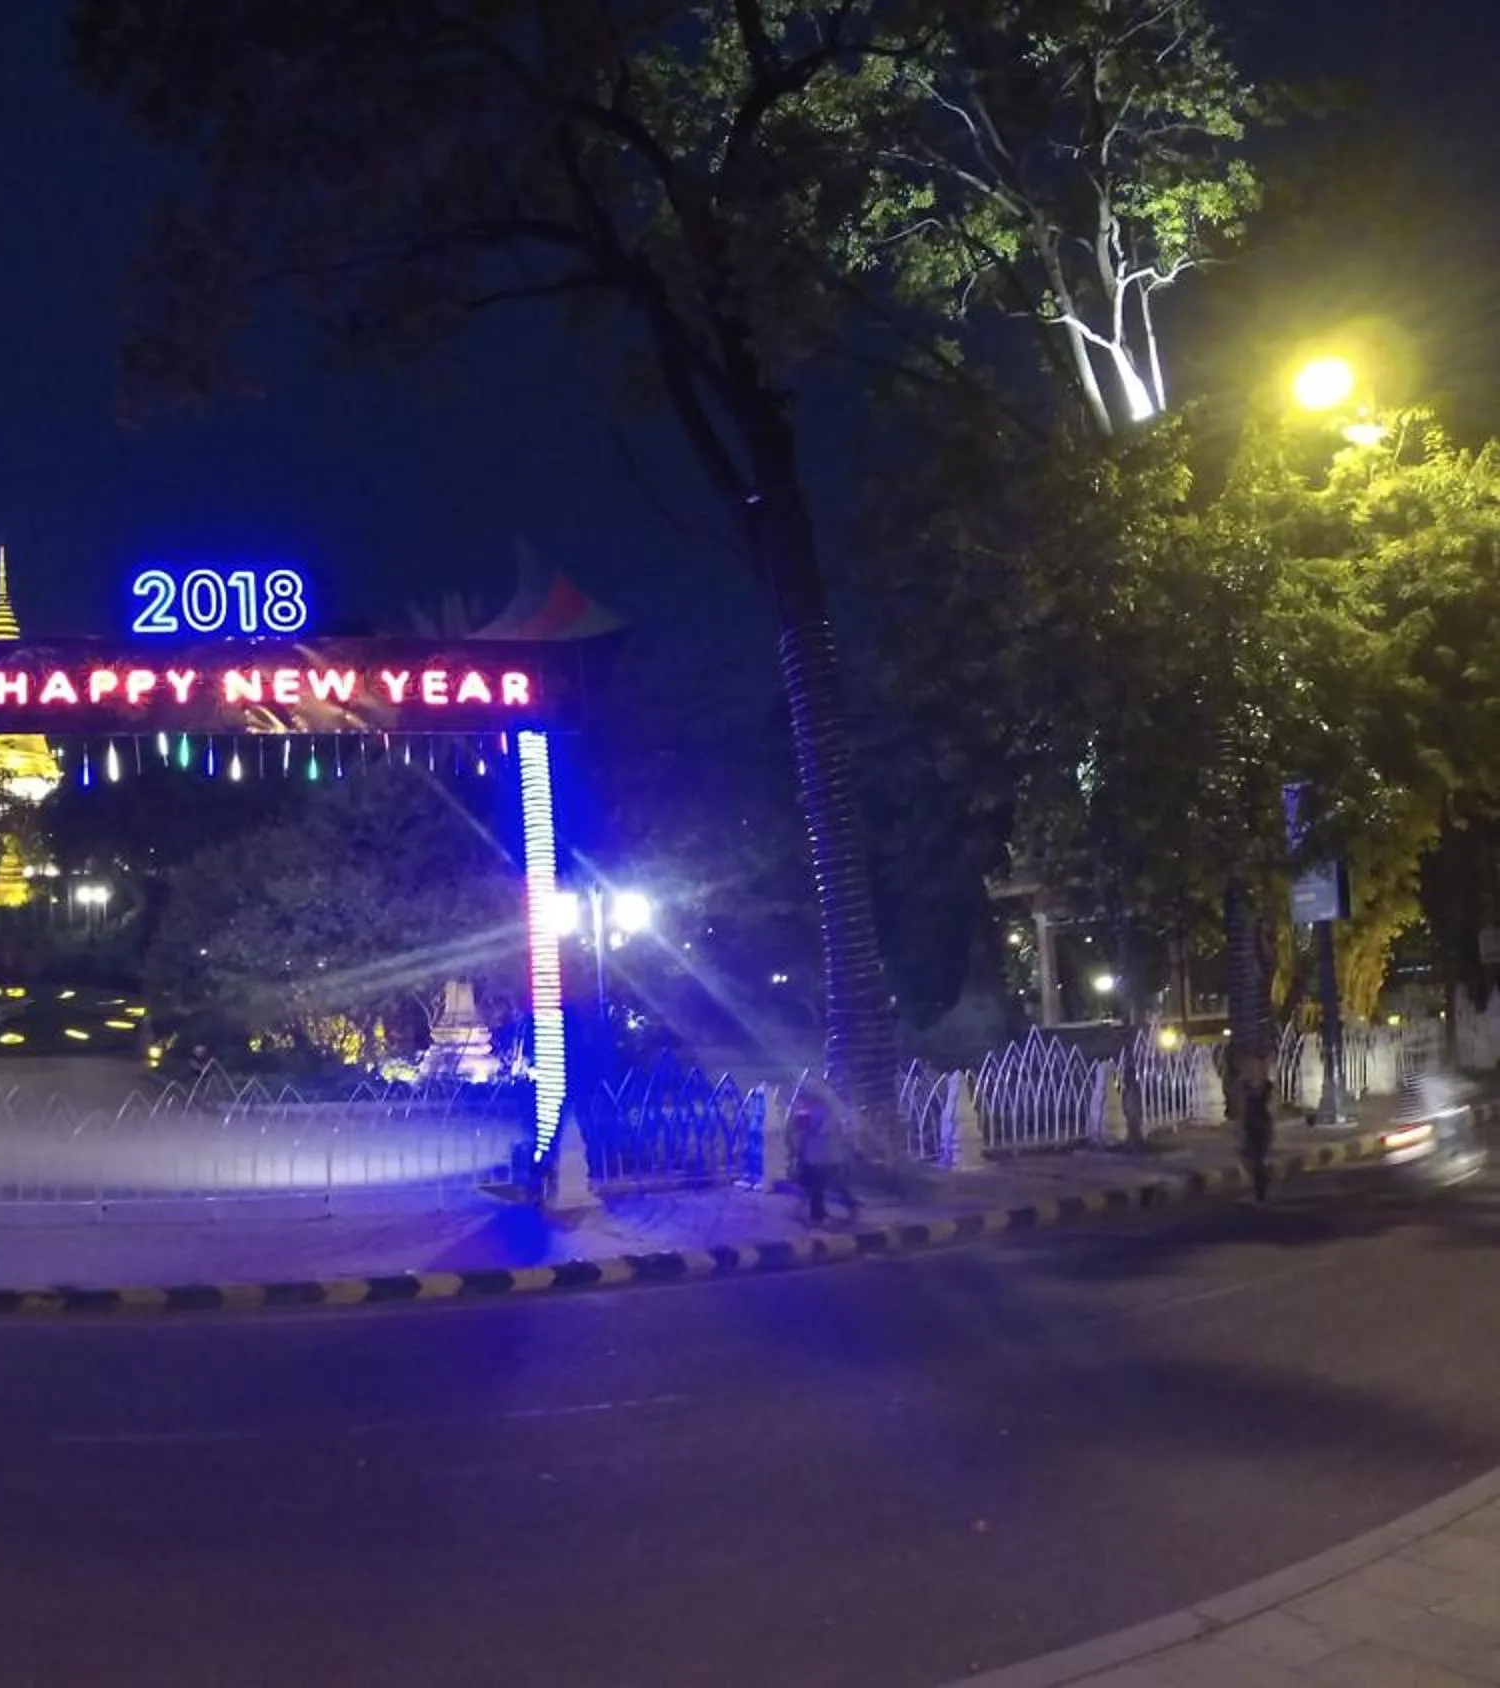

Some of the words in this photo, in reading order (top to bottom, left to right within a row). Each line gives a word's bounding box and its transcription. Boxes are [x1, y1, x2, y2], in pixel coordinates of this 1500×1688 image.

[132, 569, 308, 634] 2018
[223, 669, 356, 704] NEW
[382, 671, 531, 705] YEAR
